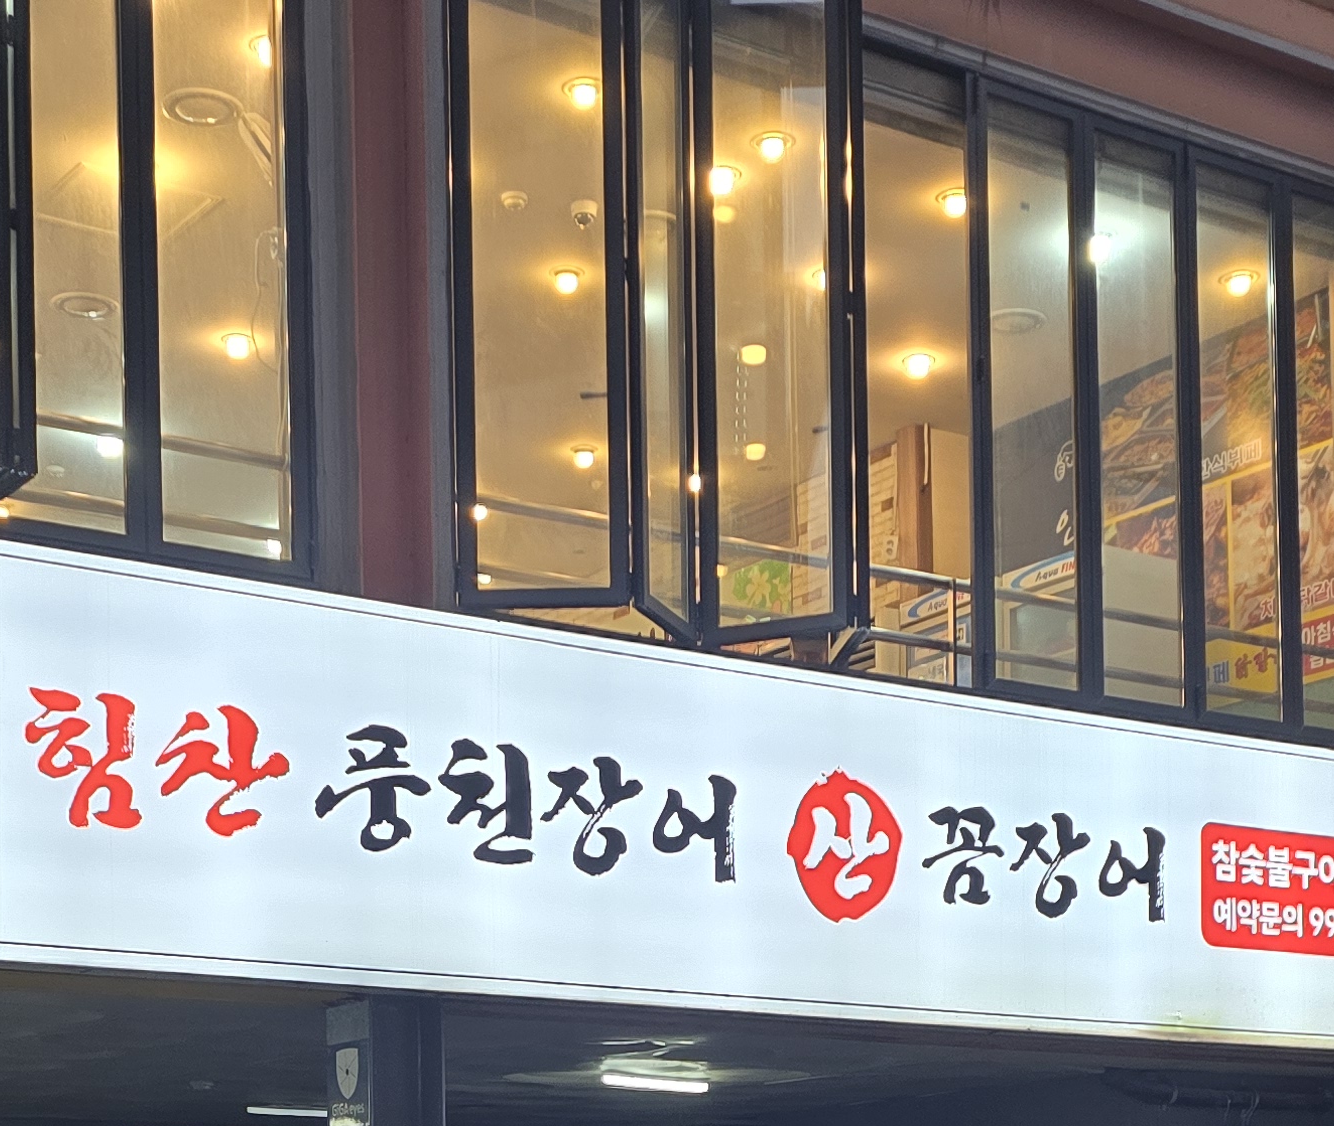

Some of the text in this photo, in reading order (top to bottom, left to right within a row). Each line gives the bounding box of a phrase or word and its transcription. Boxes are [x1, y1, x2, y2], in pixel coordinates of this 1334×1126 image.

[24, 685, 1165, 923] 힘찬 풍천장어 산 꼼장어
[1213, 897, 1304, 939] 예약문의
